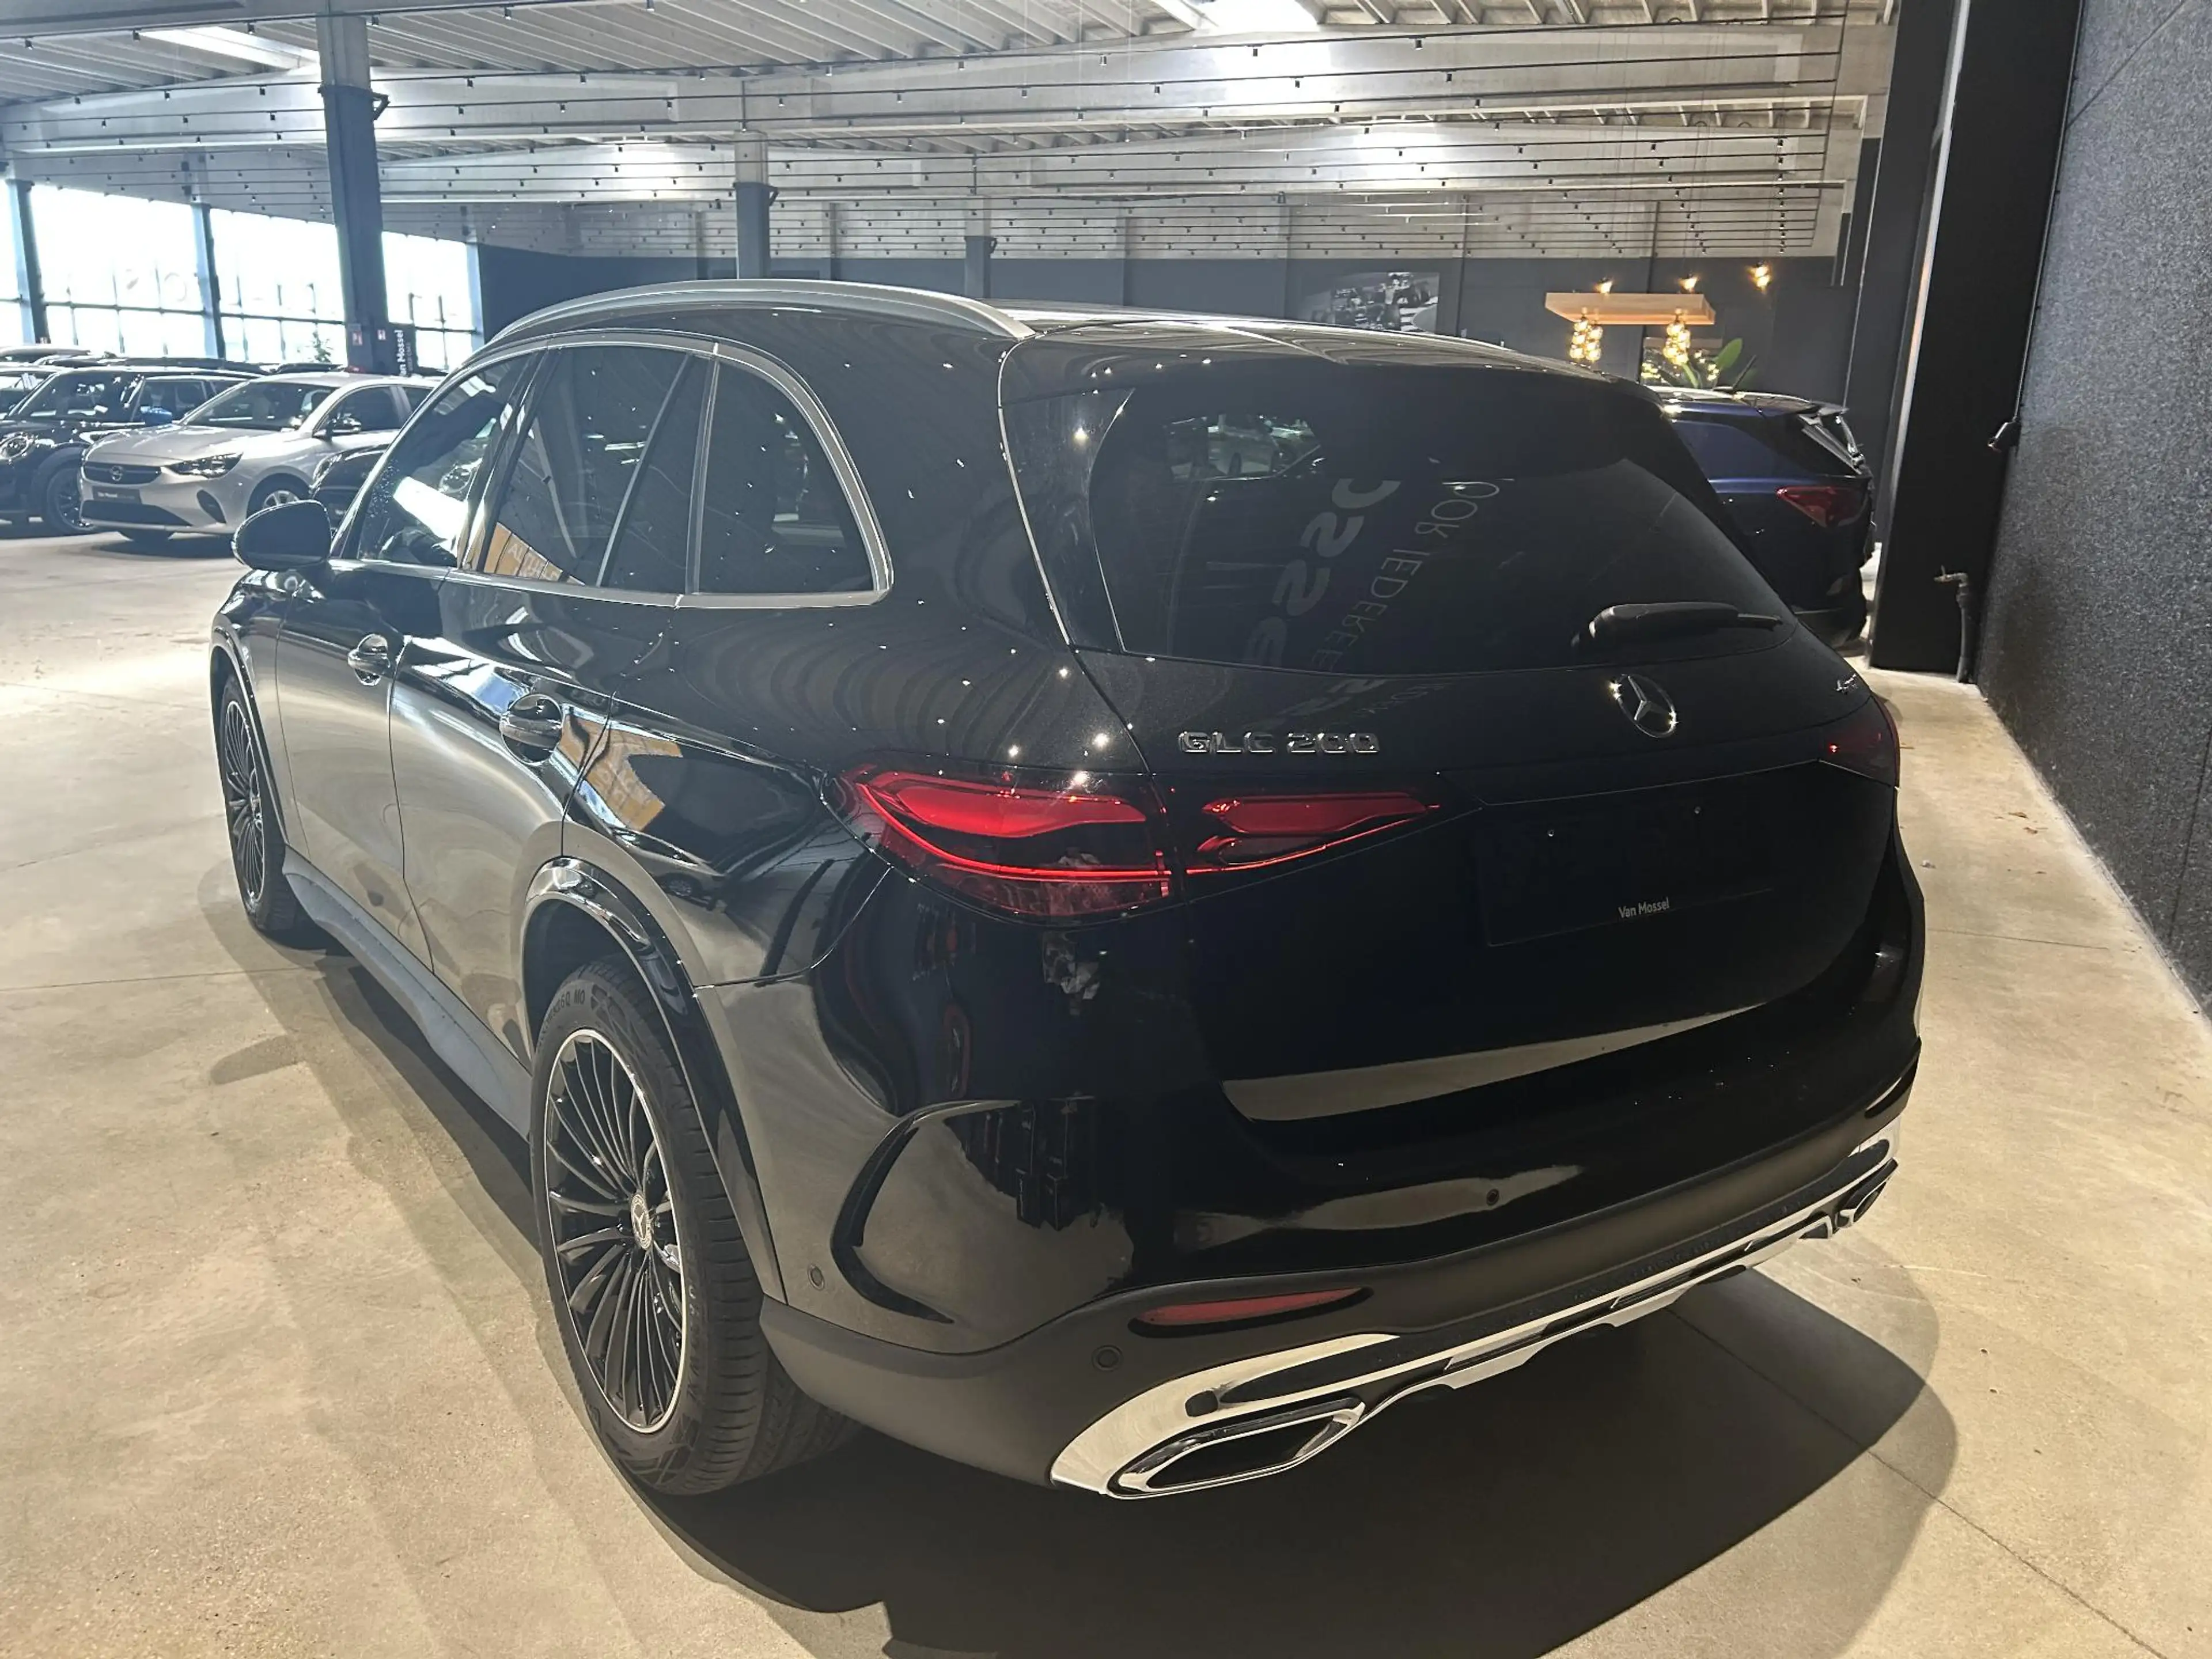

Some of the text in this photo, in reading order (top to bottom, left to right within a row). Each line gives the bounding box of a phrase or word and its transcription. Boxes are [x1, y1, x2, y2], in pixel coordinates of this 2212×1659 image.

[394, 329, 406, 362] Mossel
[1178, 731, 1276, 753] GLC
[1618, 896, 1670, 919] Van Mossel
